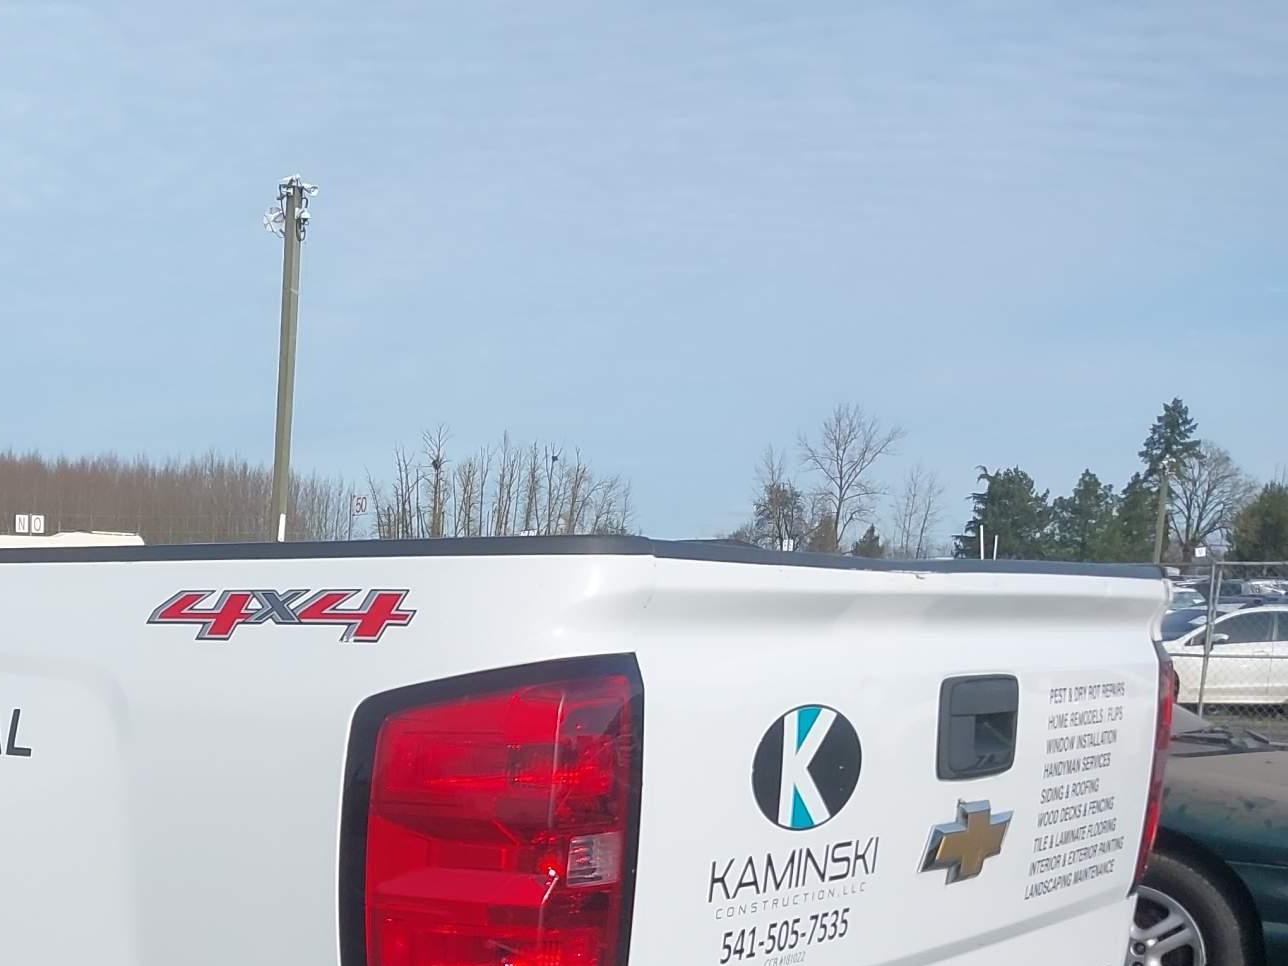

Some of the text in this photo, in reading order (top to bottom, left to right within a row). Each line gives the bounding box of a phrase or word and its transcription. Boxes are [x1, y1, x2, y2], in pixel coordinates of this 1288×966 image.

[1074, 685, 1087, 702] DRY
[1088, 684, 1101, 700] ROT
[1048, 713, 1069, 730] HOME
[1069, 708, 1104, 728] REMODELS
[1046, 729, 1117, 754] WINDOW INSTALLATION
[1043, 752, 1111, 779] HANDYMAN SERVICES
[1040, 785, 1064, 804] SIDING
[1071, 778, 1100, 797] ROOFING
[1037, 810, 1060, 828] WOOD
[1059, 803, 1082, 823] DECKS
[1088, 796, 1115, 815] FENCING
[1033, 835, 1049, 853] TILE
[1054, 825, 1087, 847] LAMINATE
[1087, 817, 1117, 838] FLOORING
[708, 836, 880, 903] KAMINSKI
[1029, 854, 1062, 876] INTERIOR
[1067, 843, 1098, 865] EXTERIOR
[1098, 836, 1125, 856] PAINTING
[1024, 858, 1115, 900] LANDSCAPING MAINTENANCE
[720, 907, 850, 965] 541-505-7535
